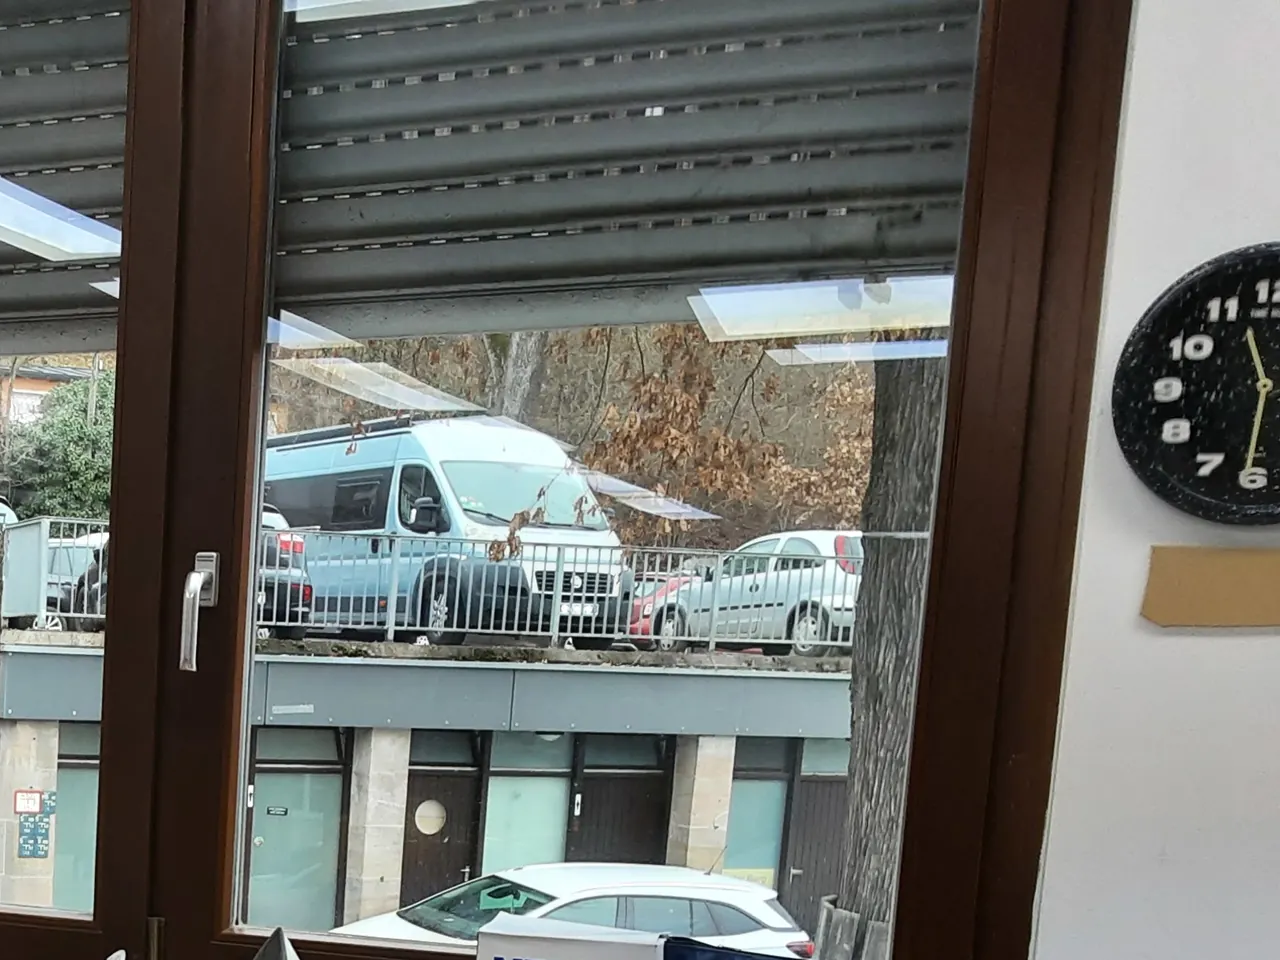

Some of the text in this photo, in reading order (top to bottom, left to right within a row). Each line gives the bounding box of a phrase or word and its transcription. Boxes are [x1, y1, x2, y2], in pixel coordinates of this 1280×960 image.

[1206, 296, 1239, 322] 11
[1169, 334, 1214, 361] 10
[1153, 377, 1183, 403] 9
[1162, 418, 1191, 444] 8
[1195, 452, 1225, 477] 7
[1238, 466, 1268, 490] 6
